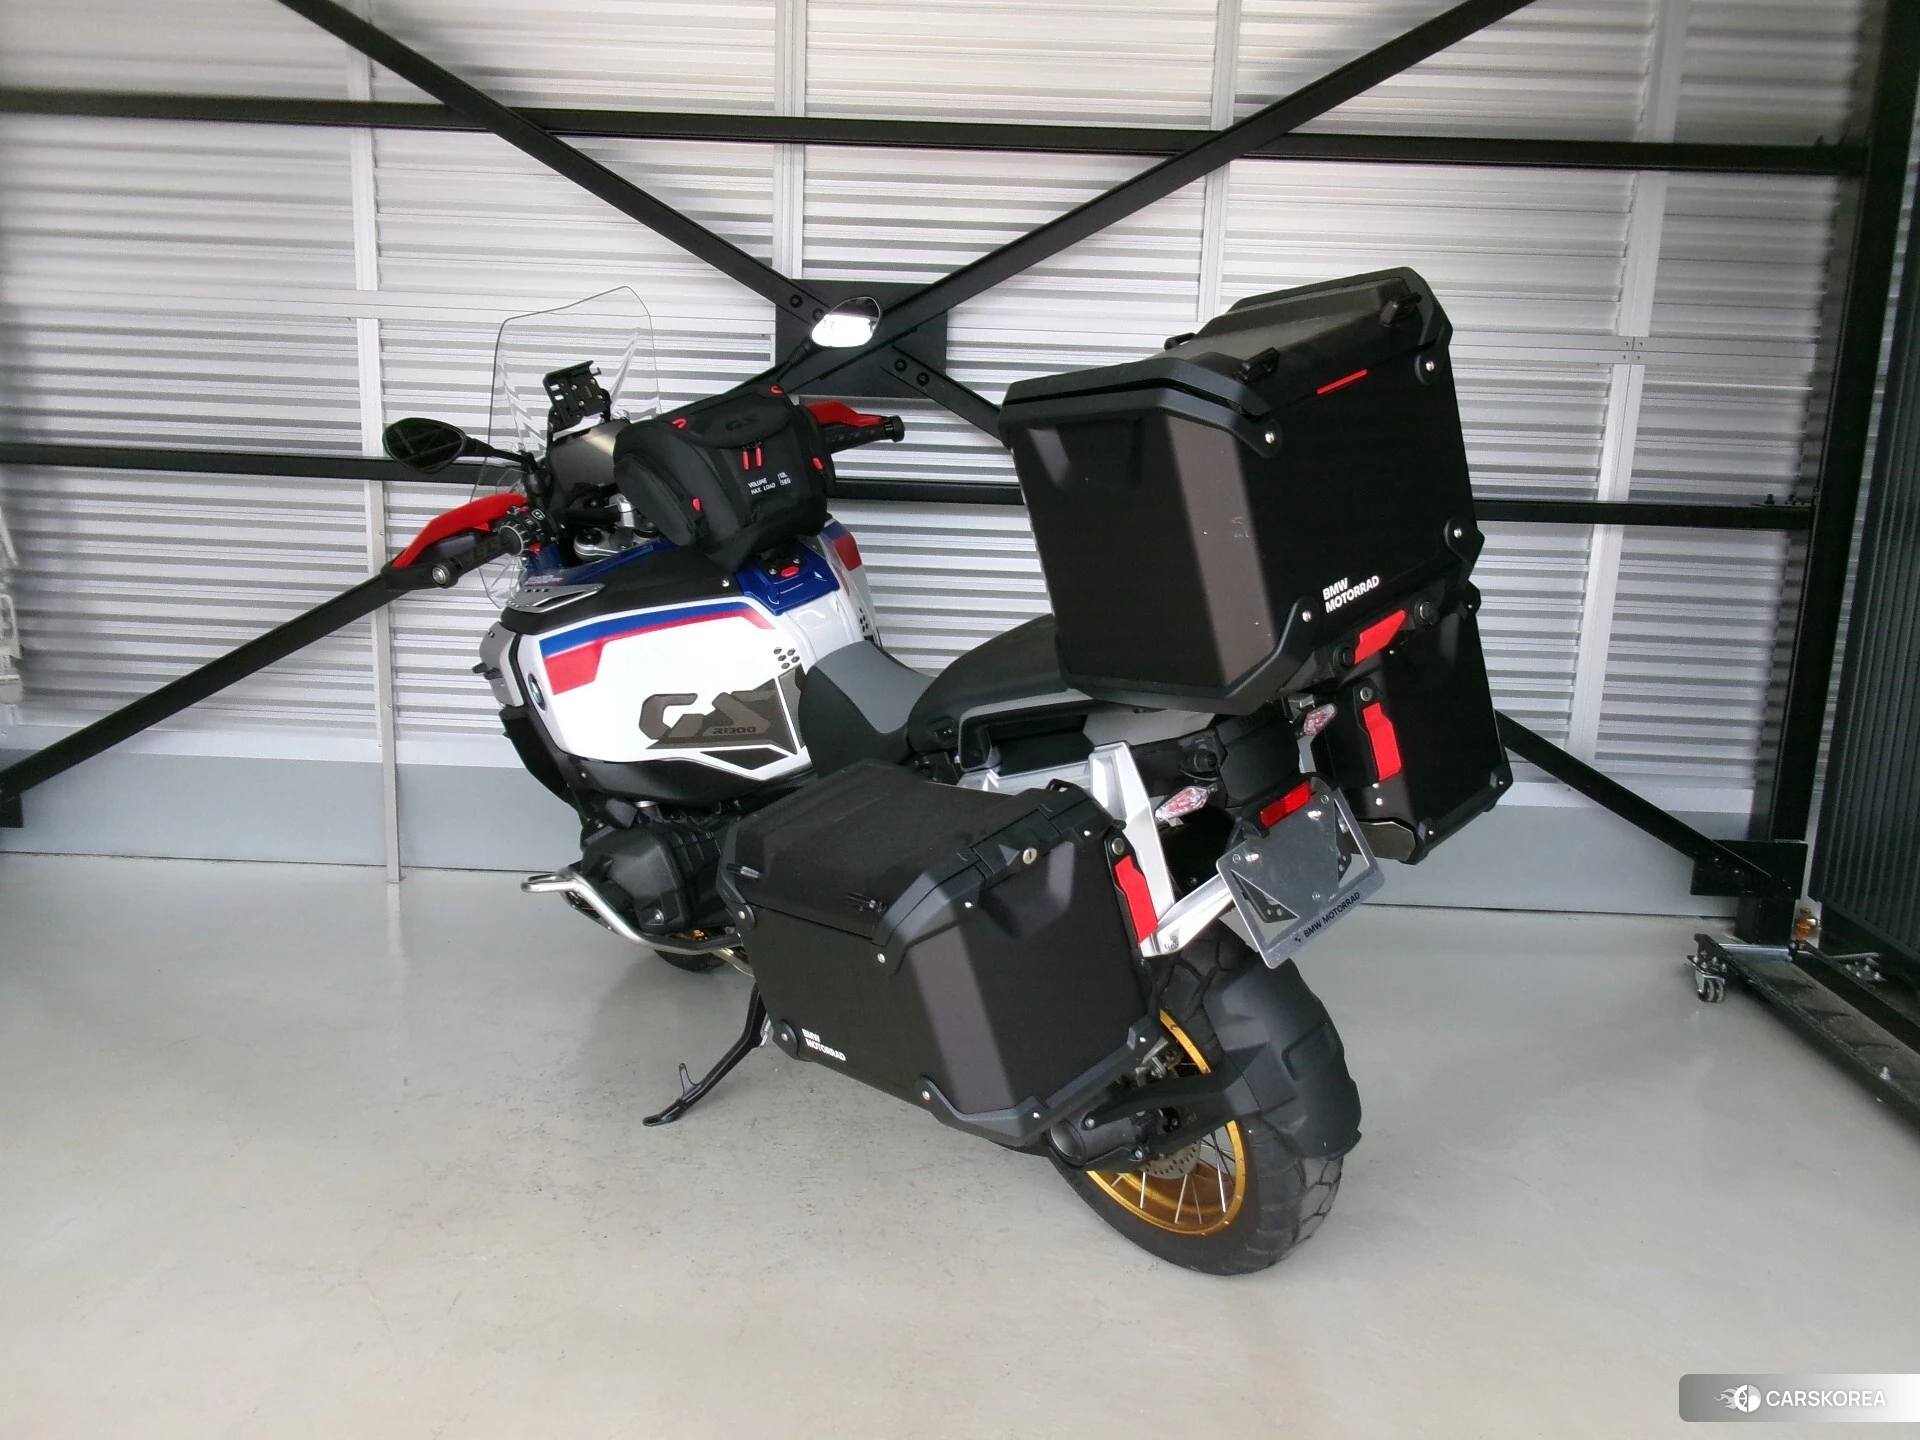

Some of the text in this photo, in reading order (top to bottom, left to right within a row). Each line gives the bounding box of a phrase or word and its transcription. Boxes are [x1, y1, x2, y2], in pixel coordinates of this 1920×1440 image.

[763, 482, 776, 491] LOAD
[1322, 577, 1349, 601] BMW
[1325, 575, 1380, 614] MOTORRAD
[713, 726, 757, 735] R1300
[1303, 891, 1361, 939] BMW MOTORRAD
[801, 1028, 821, 1043] BMW
[805, 1037, 846, 1062] MOTORRAD
